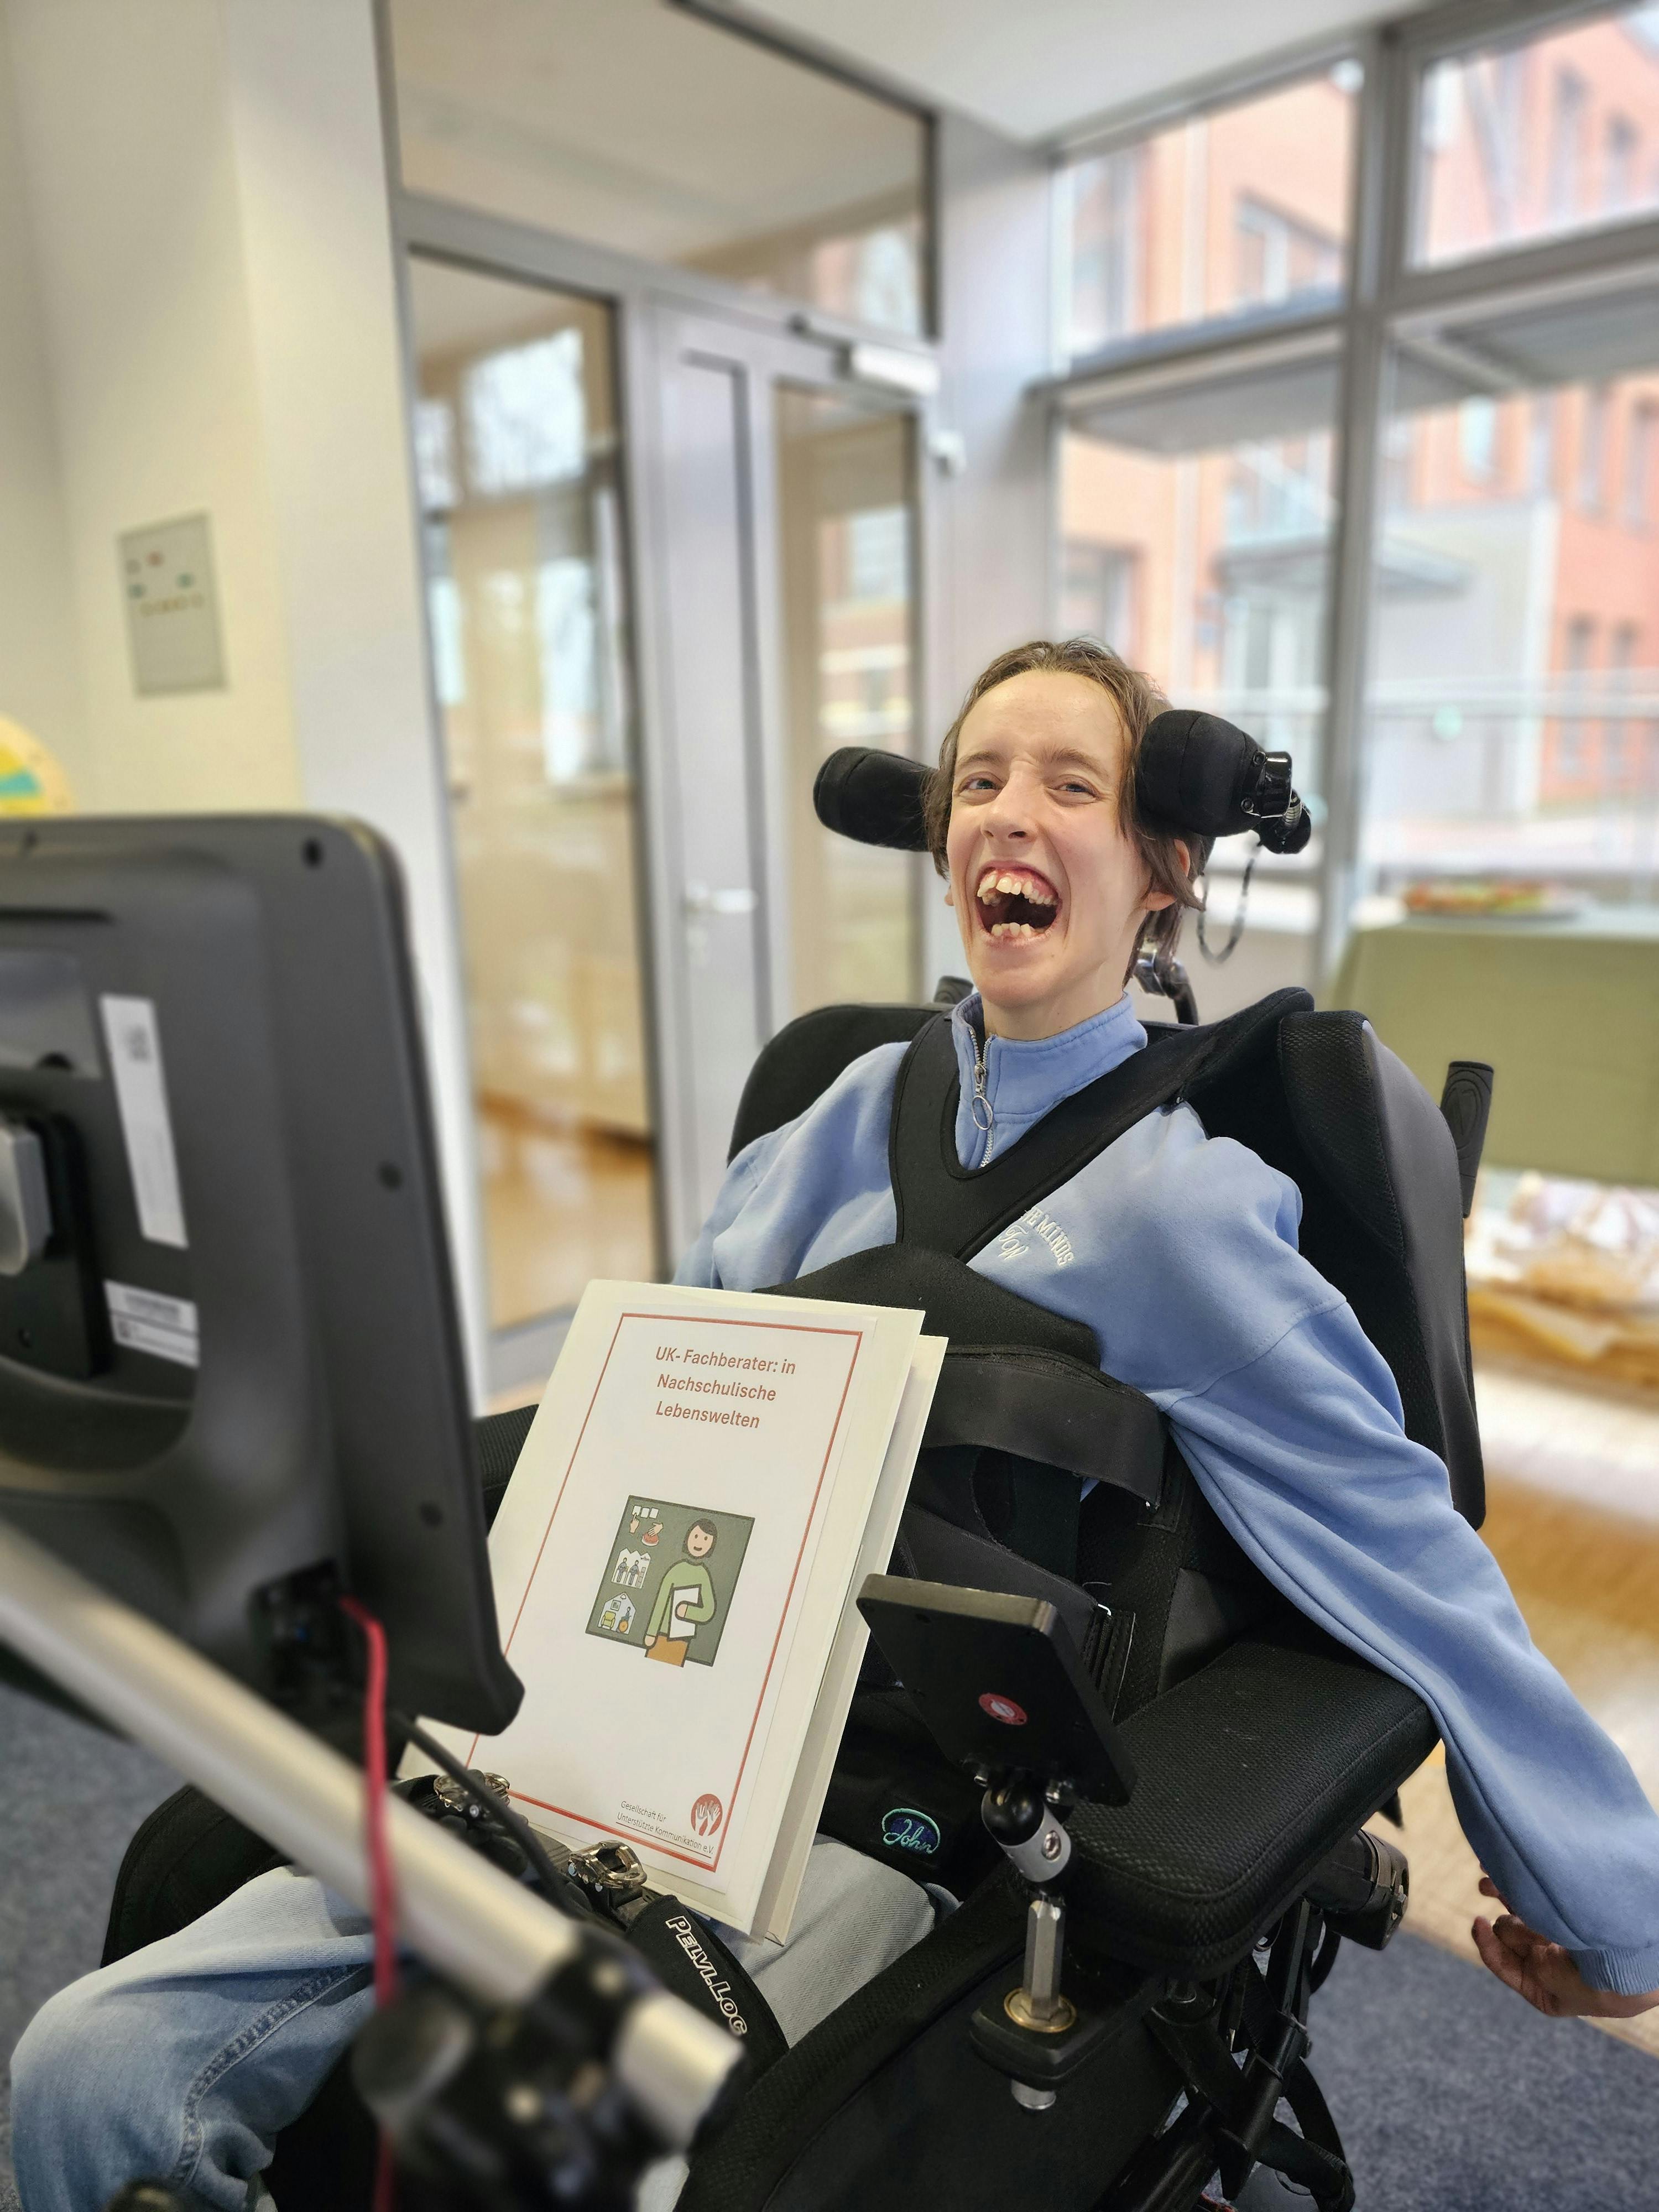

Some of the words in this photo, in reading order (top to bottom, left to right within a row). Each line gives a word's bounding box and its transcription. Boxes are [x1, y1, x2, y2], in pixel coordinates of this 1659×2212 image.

[1034, 1214, 1075, 1266] MINDS
[655, 1346, 680, 1361] UK-
[683, 1349, 779, 1373] Fachberater:
[781, 1358, 796, 1374] in
[657, 1373, 776, 1401] Nachschulische
[655, 1401, 761, 1428] Lebenswelten
[621, 1801, 656, 1820] Gesellschaft
[656, 1813, 667, 1823] für
[617, 1812, 654, 1832] Unterstützte
[655, 1827, 702, 1850] Kommunikation
[703, 1844, 714, 1855] e.V.
[883, 1819, 933, 1854] John
